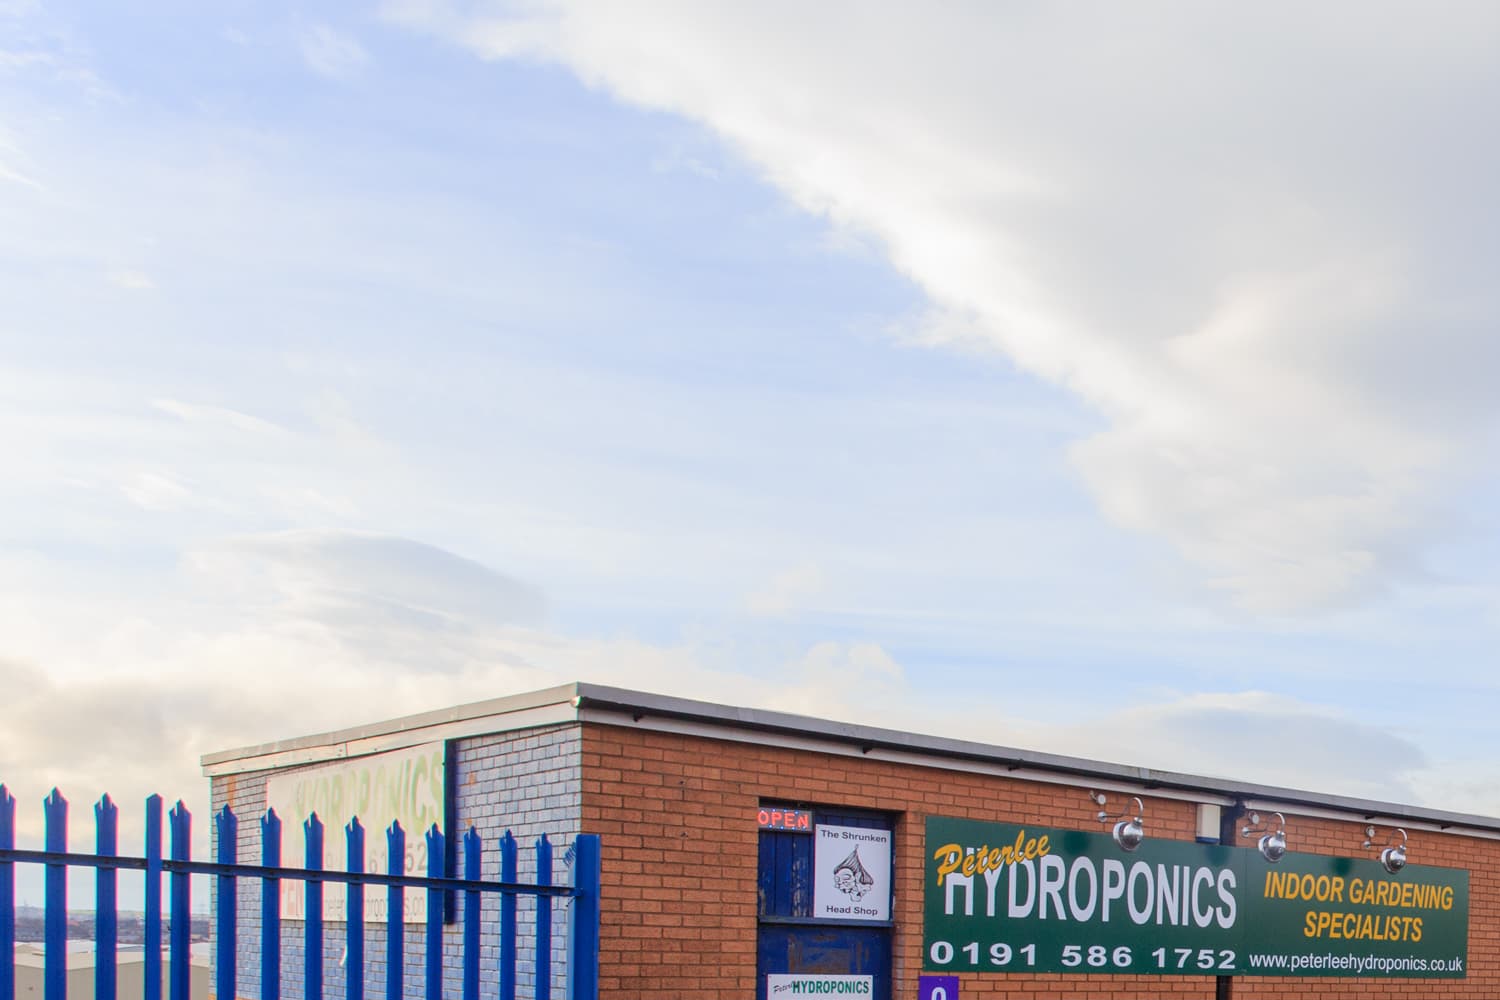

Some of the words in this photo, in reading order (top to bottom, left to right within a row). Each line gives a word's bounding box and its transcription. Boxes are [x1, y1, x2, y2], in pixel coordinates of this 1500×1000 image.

[758, 811, 809, 828] OPEN
[821, 830, 839, 839] The
[842, 831, 887, 843] Shrunken
[933, 830, 1051, 887] Peterlee
[945, 847, 1237, 929] HYDROPONICS
[1264, 871, 1345, 902] INDOOR
[1349, 878, 1454, 910] GARDENING
[826, 905, 851, 914] Head
[854, 907, 878, 916] Shop
[1304, 911, 1424, 942] SPECIALISTS
[929, 941, 1036, 966] 0191
[1061, 945, 1132, 967] 586
[1152, 947, 1236, 970] 1752
[1249, 953, 1463, 974] www.peterleehydroponics.co.uk
[792, 981, 869, 994] HYDROPONICS
